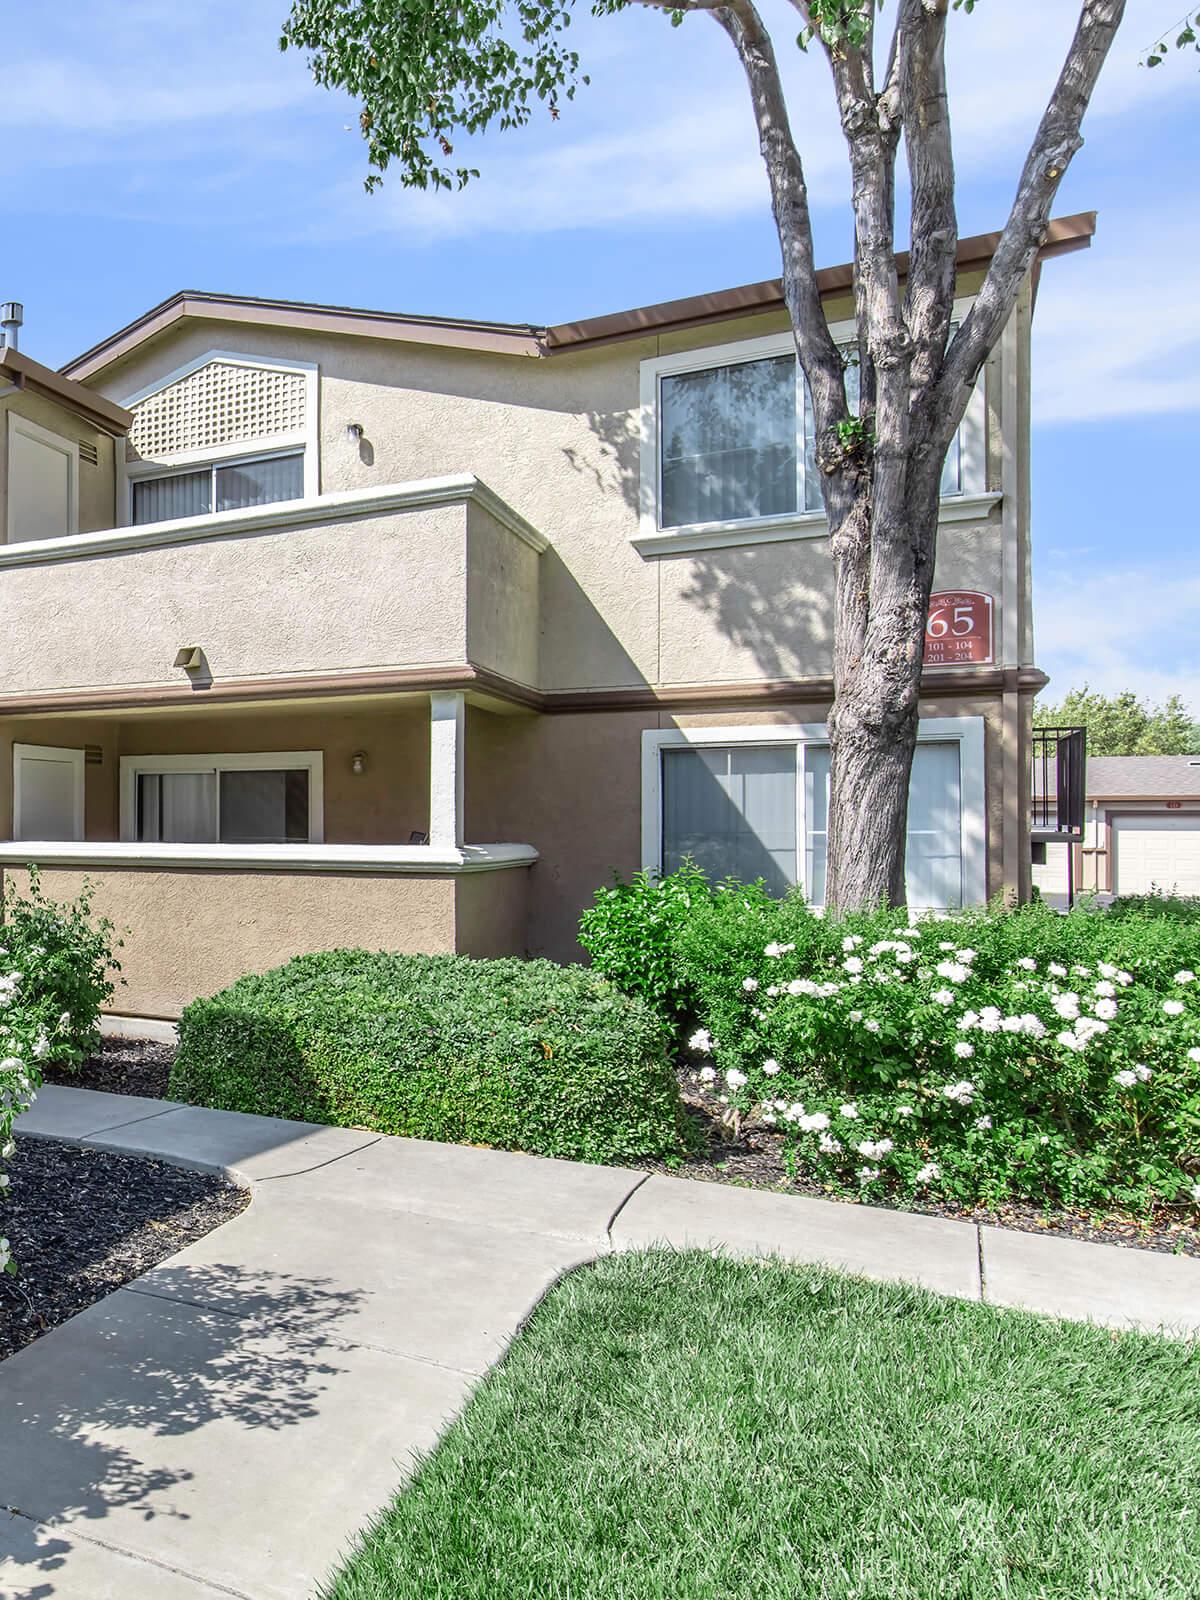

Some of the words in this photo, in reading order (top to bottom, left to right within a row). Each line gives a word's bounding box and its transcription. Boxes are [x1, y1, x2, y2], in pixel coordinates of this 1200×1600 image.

[926, 606, 974, 637] 65
[955, 641, 973, 649] 104
[928, 654, 944, 662] 201
[955, 652, 973, 660] 204
